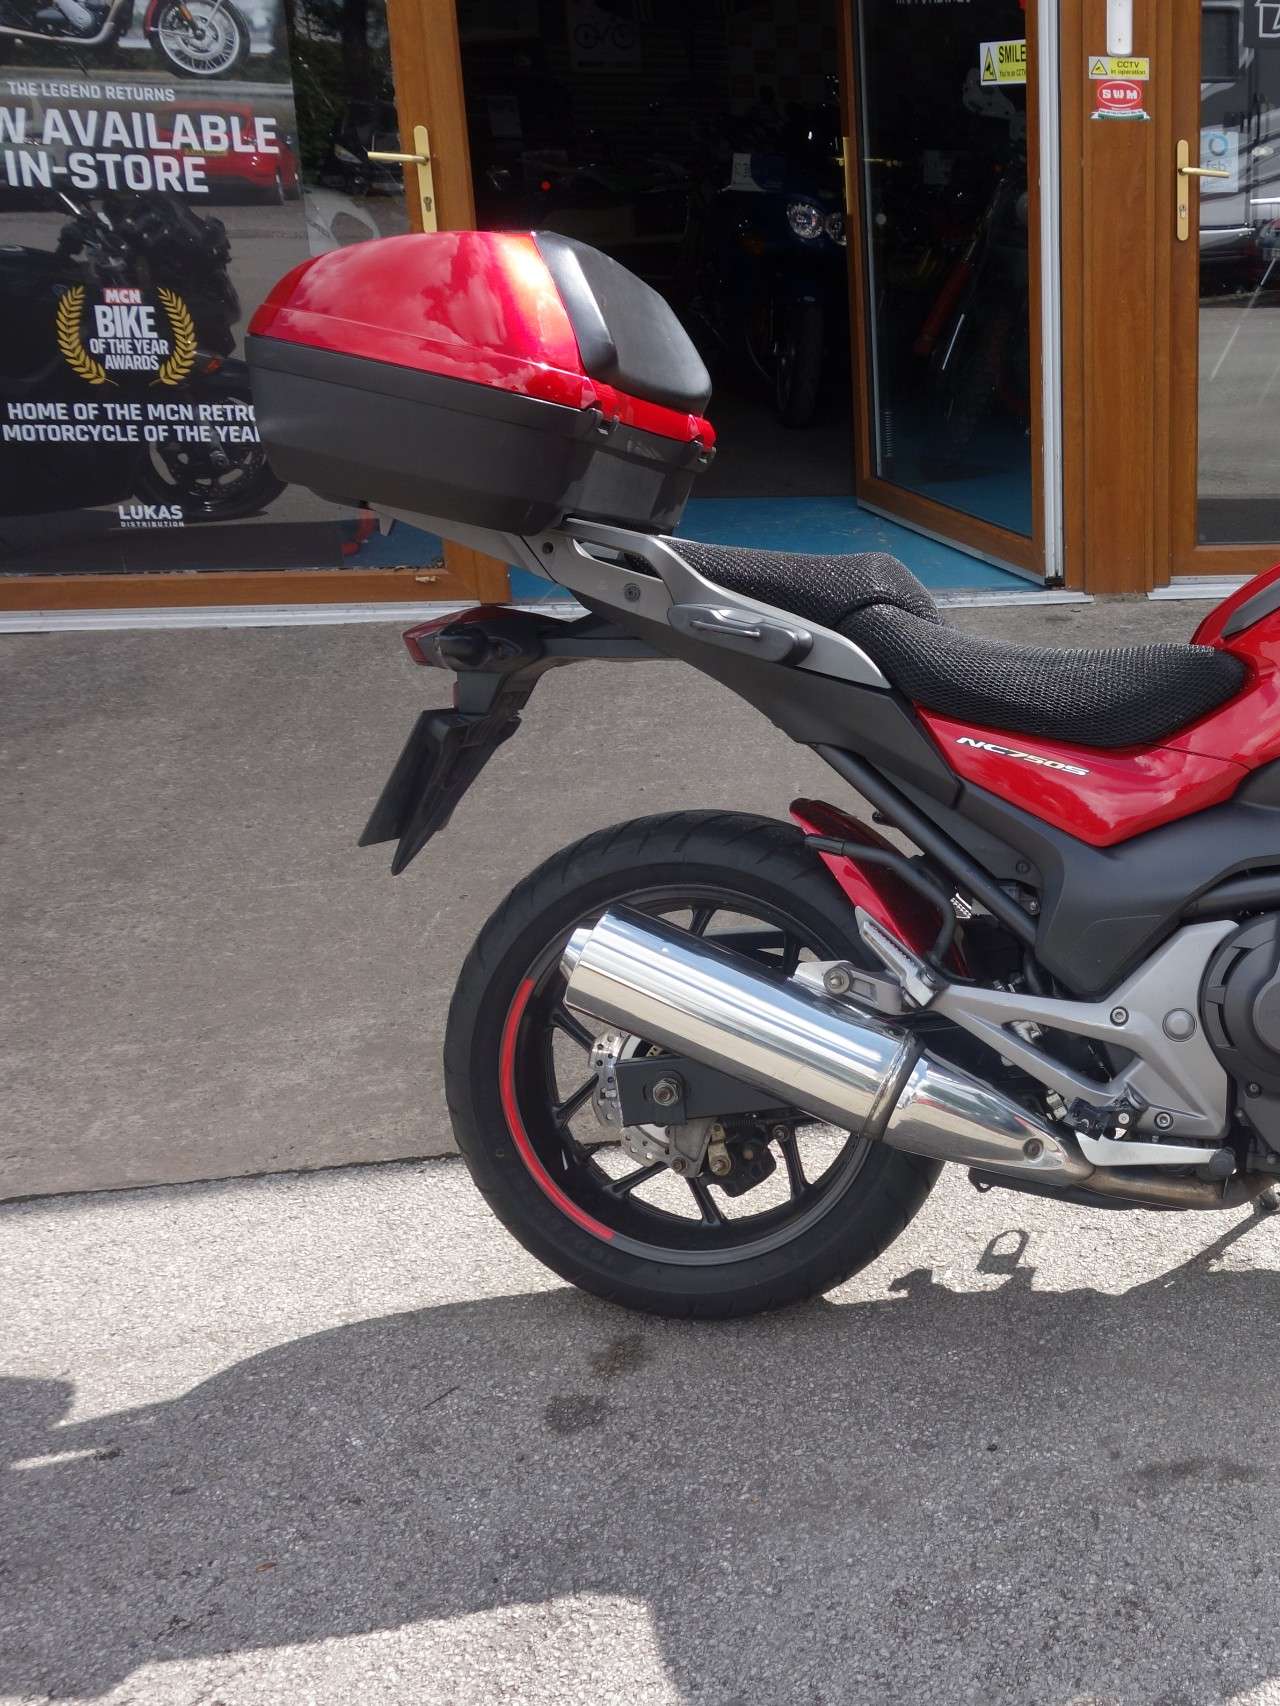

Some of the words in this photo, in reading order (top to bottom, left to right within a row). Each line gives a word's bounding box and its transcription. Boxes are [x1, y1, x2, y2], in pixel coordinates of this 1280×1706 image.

[998, 43, 1027, 64] SMILE
[1116, 61, 1140, 69] CCTV
[7, 81, 37, 97] THE
[41, 82, 101, 99] LEGEND
[105, 85, 175, 102] RETURNS
[42, 107, 279, 154] AVAILABLE
[5, 150, 209, 193] IN-STORE
[104, 289, 142, 304] MCN
[94, 305, 159, 339] BIKE
[90, 338, 107, 354] OF
[107, 339, 134, 354] THE
[134, 340, 169, 355] YEAR
[105, 354, 160, 370] AWARDS
[8, 402, 67, 420] HOME
[73, 403, 99, 420] OF
[103, 403, 142, 420] THE
[148, 404, 193, 420] MCN
[3, 424, 138, 442] MOTORCYCLE
[144, 425, 168, 442] OF
[173, 426, 211, 442] THE
[118, 505, 183, 519] LUKAS
[955, 736, 1090, 776] NC750S
